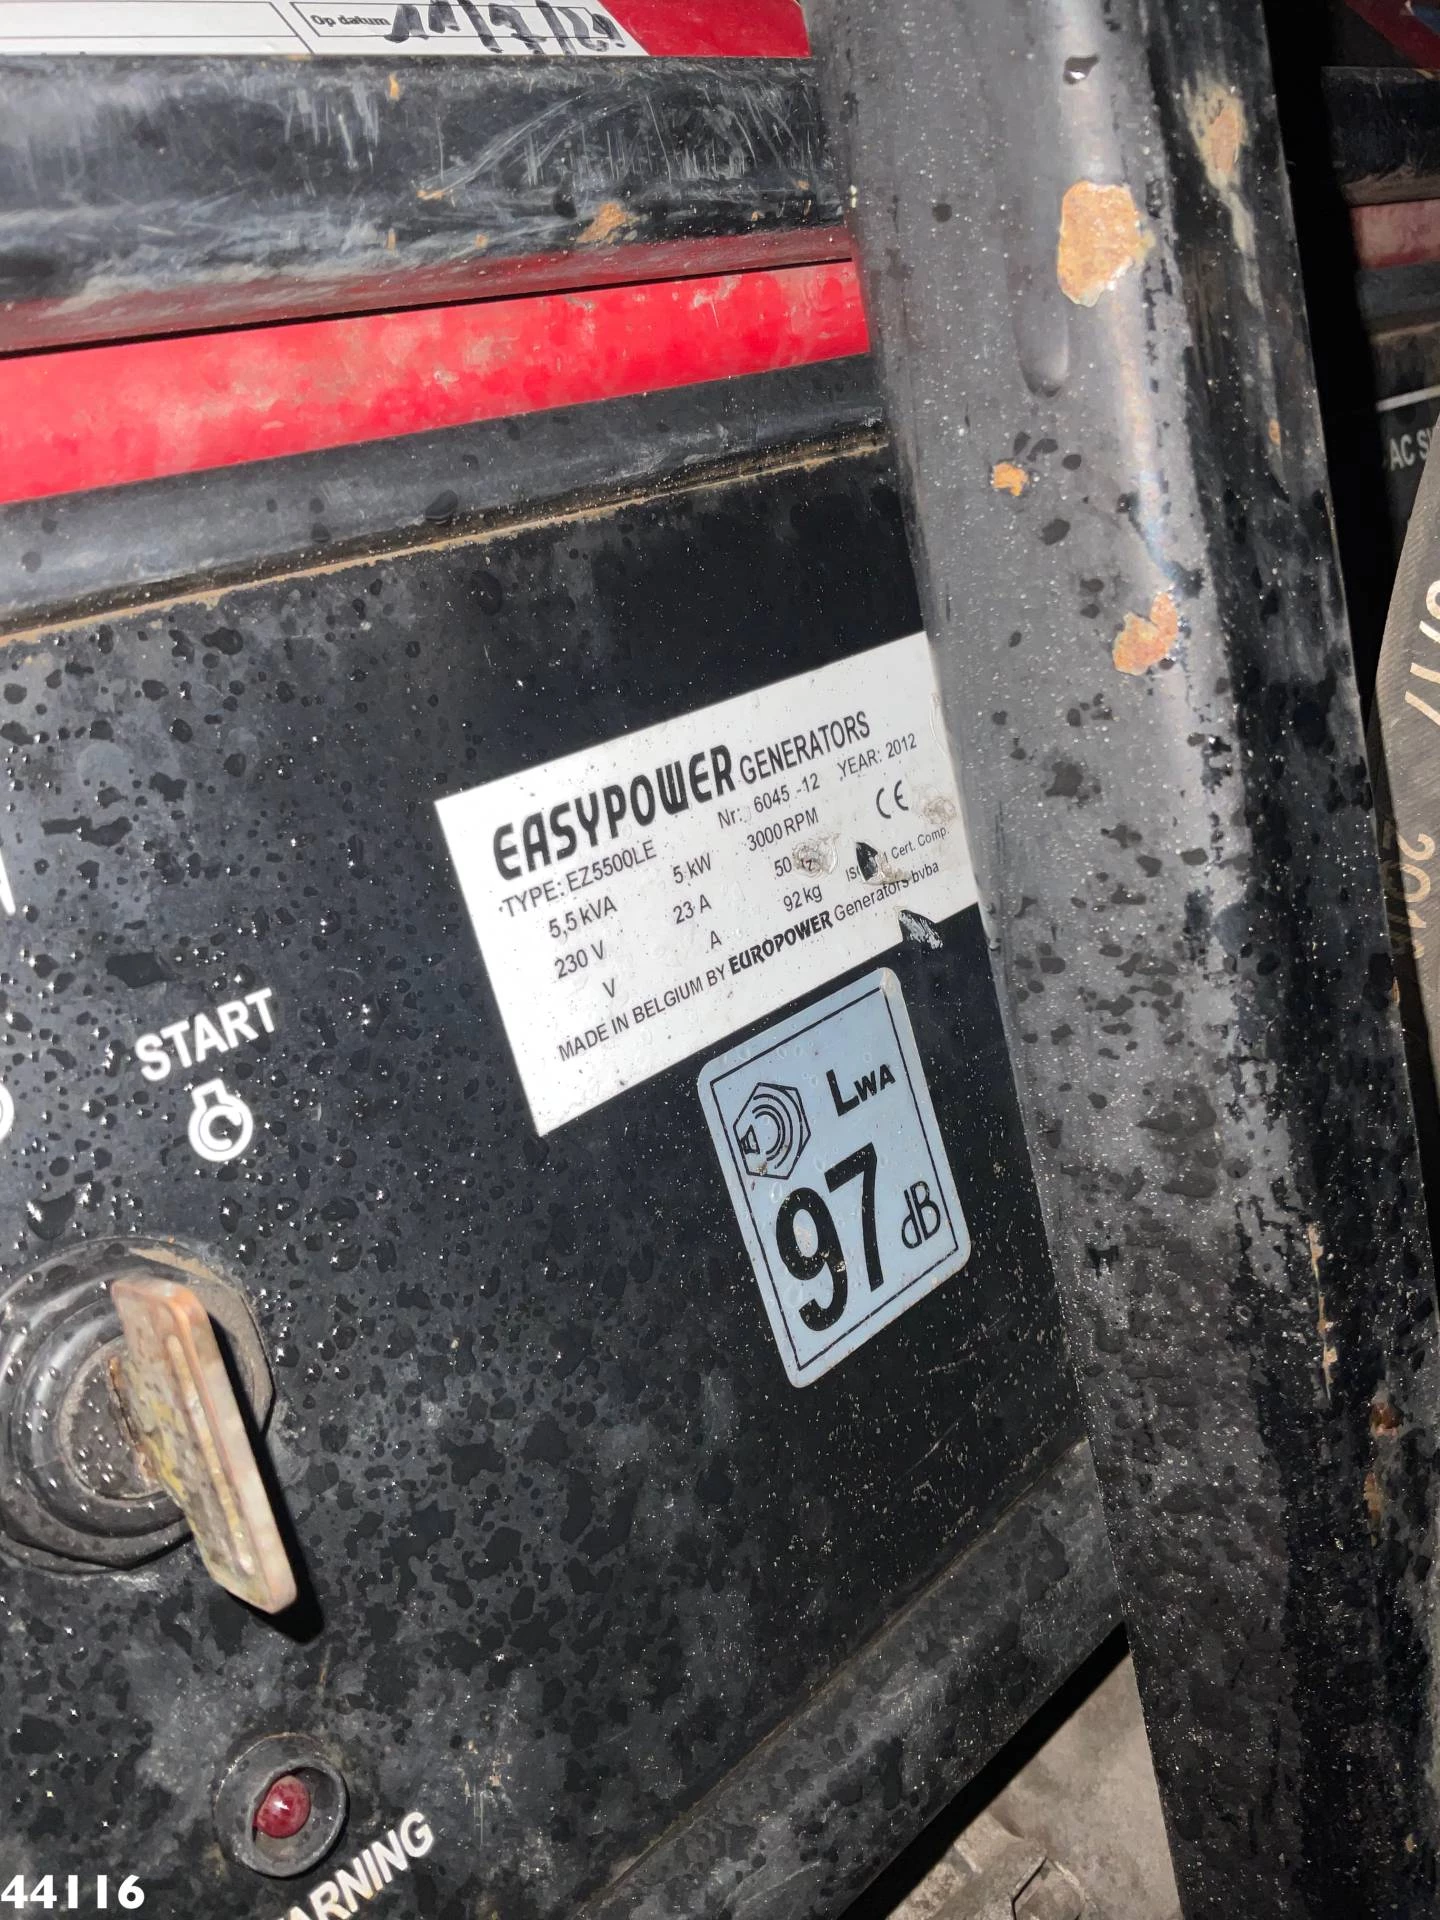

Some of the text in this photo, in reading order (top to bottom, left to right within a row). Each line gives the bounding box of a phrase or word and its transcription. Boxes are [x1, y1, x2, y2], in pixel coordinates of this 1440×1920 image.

[310, 14, 392, 27] Op datum
[1389, 428, 1432, 471] AC S
[837, 733, 918, 780] YEAR: 2012
[492, 711, 871, 881] EASYPOWER GENERATORS
[717, 772, 821, 829] Nr: 6045 -12
[746, 807, 820, 852] 3000 RPM
[891, 841, 917, 860] Cert.
[917, 828, 951, 848] Comp.
[502, 839, 658, 917] TYPE: EZ5500LE
[672, 853, 713, 884] 5 kW
[773, 856, 792, 878] 50
[548, 896, 618, 940] 5,5 kVA
[672, 894, 712, 924] 23 A
[783, 883, 823, 912] 92 kg
[553, 940, 605, 979] 230 V
[557, 1023, 610, 1062] MADE
[611, 1015, 630, 1035] IN
[631, 976, 704, 1024] BELGIUM
[706, 963, 728, 988] BY
[728, 909, 834, 976] EUROPOWER
[834, 879, 910, 922] Generators
[911, 861, 940, 884] bvba
[709, 930, 723, 950] A
[602, 978, 616, 998] V
[135, 987, 276, 1081] START
[901, 1179, 942, 1250] dB
[775, 1142, 886, 1333] 97
